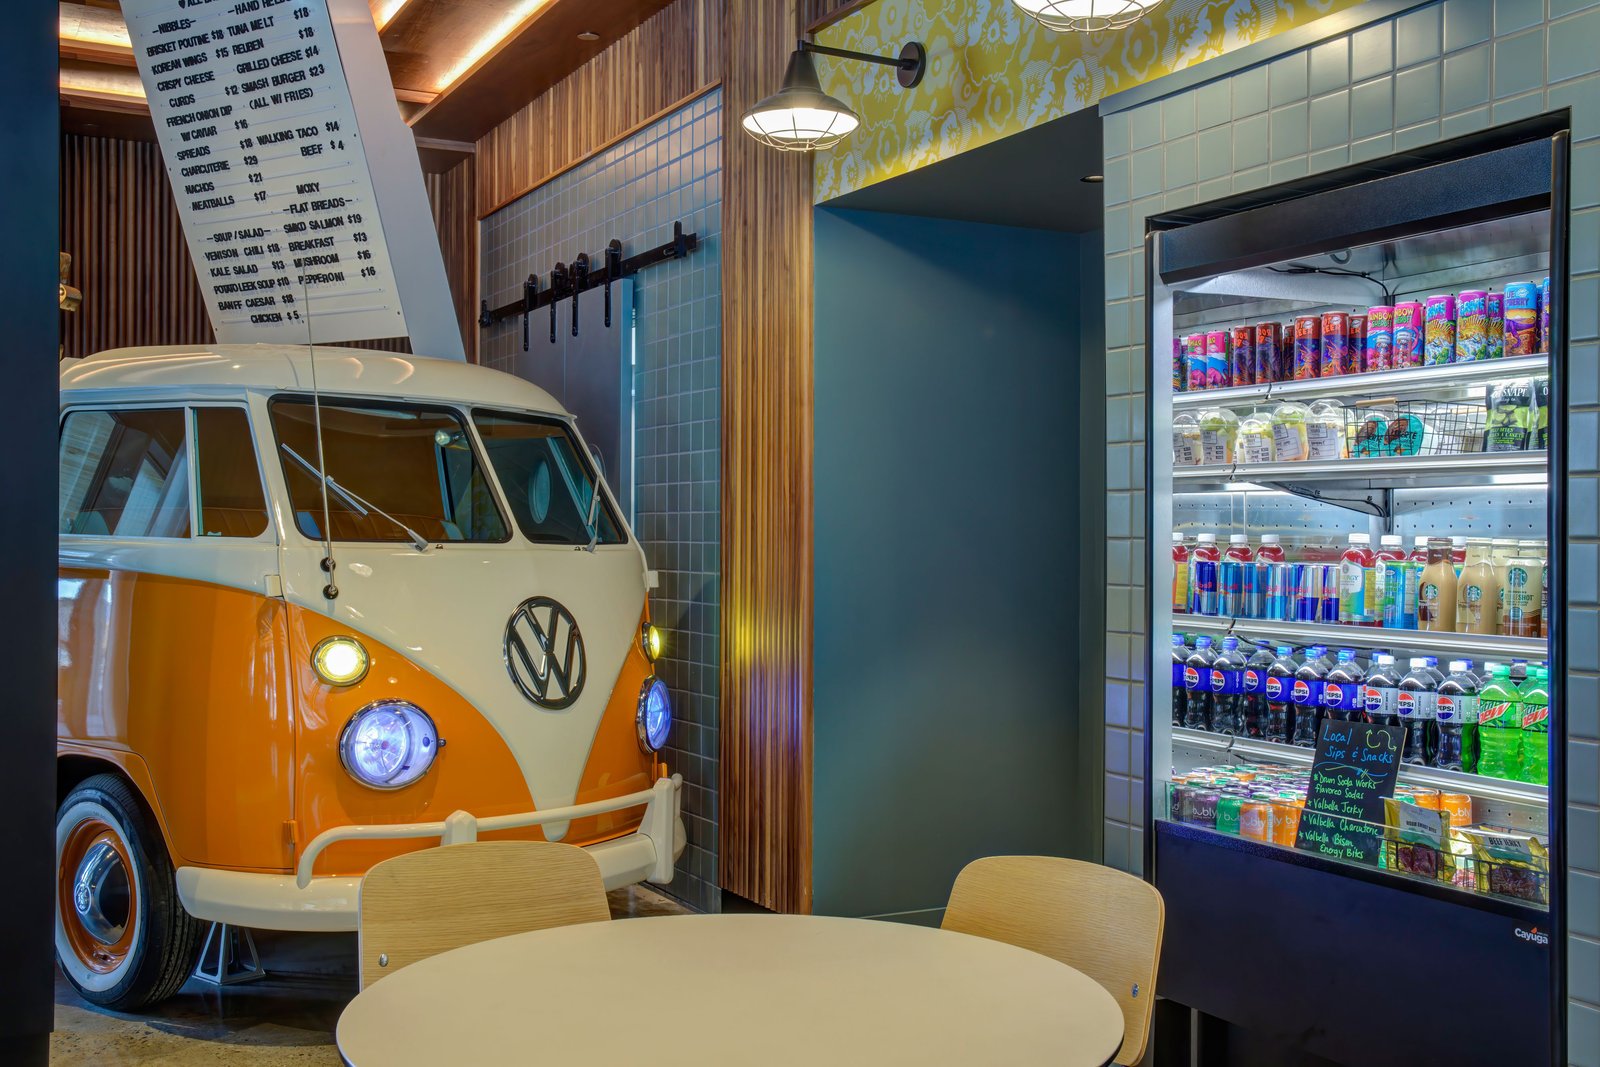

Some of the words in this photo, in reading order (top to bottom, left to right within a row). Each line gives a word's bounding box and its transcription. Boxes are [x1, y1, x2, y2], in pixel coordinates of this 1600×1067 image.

[226, 22, 249, 37] TUNA
[250, 15, 274, 31] MELT
[293, 7, 309, 20] $18
[146, 41, 177, 57] BRISKET
[178, 33, 210, 50] POUTINE
[211, 29, 225, 40] $18
[232, 38, 264, 55] REUBEN
[298, 26, 314, 39] $18
[151, 58, 182, 75] KOREAN
[182, 52, 208, 68] WINGS
[215, 46, 229, 59] $15
[236, 58, 269, 74] GRILLED
[270, 49, 303, 67] CHEESE
[304, 45, 319, 58] $14
[157, 78, 181, 91] CRISPY
[183, 71, 215, 86] CHEESE
[241, 77, 269, 93] SMASH
[271, 70, 306, 87] BURGER
[308, 63, 325, 77] $23
[169, 94, 195, 108] CURDS
[224, 84, 239, 96] $12
[249, 96, 269, 110] (ALL
[283, 87, 314, 103] FRIES)
[166, 112, 196, 128] FRENCH
[196, 107, 220, 122] ONION
[219, 105, 233, 117] DIP
[191, 125, 218, 140] CAVIAR
[234, 118, 249, 130] $16
[256, 129, 294, 146] WALKING
[295, 125, 319, 139] TACO
[325, 120, 340, 132] $14
[176, 145, 211, 161] SPREADS
[300, 143, 323, 157] BEEF
[181, 160, 231, 177] CHARCUTERIE
[243, 155, 258, 166] $29
[184, 181, 215, 195] NACHOS
[248, 172, 263, 183] $21
[296, 182, 320, 195] MOXY
[192, 195, 235, 211] MEATBALLS
[253, 190, 267, 202] $17
[308, 215, 345, 231] SALMON
[347, 213, 362, 224] $19
[288, 236, 334, 252] BREAKFAST
[352, 231, 368, 243] $13
[204, 248, 239, 261] VENISON
[243, 245, 264, 257] CHILI
[266, 242, 281, 253] $18
[357, 249, 372, 260] $16
[210, 266, 231, 278] KALE
[232, 263, 259, 275] SALAD
[271, 260, 285, 270] $13
[297, 271, 345, 285] PEPPERONI
[360, 266, 376, 278] $16
[213, 283, 239, 295] POTATO
[239, 281, 257, 292] LEEK
[257, 278, 275, 290] SOUP
[276, 276, 290, 287] $10
[218, 300, 243, 311] BANFF
[245, 296, 276, 308] CAESAR
[250, 312, 283, 324] CHICKEN
[1323, 724, 1353, 745] Local
[1325, 745, 1346, 760] Sips
[1361, 748, 1394, 764] Snacks
[1337, 774, 1353, 787] Soda
[1355, 779, 1377, 789] Works
[1344, 788, 1364, 799] Sodas
[1192, 804, 1218, 819] bubly
[1313, 799, 1339, 812] Valbella
[1341, 802, 1364, 818] Jerky
[1308, 814, 1335, 829] Valbella
[1305, 831, 1329, 845] Valbella
[1488, 837, 1503, 846] BEEF
[1503, 838, 1522, 848] JERKY
[1514, 927, 1549, 944] Cayuga
